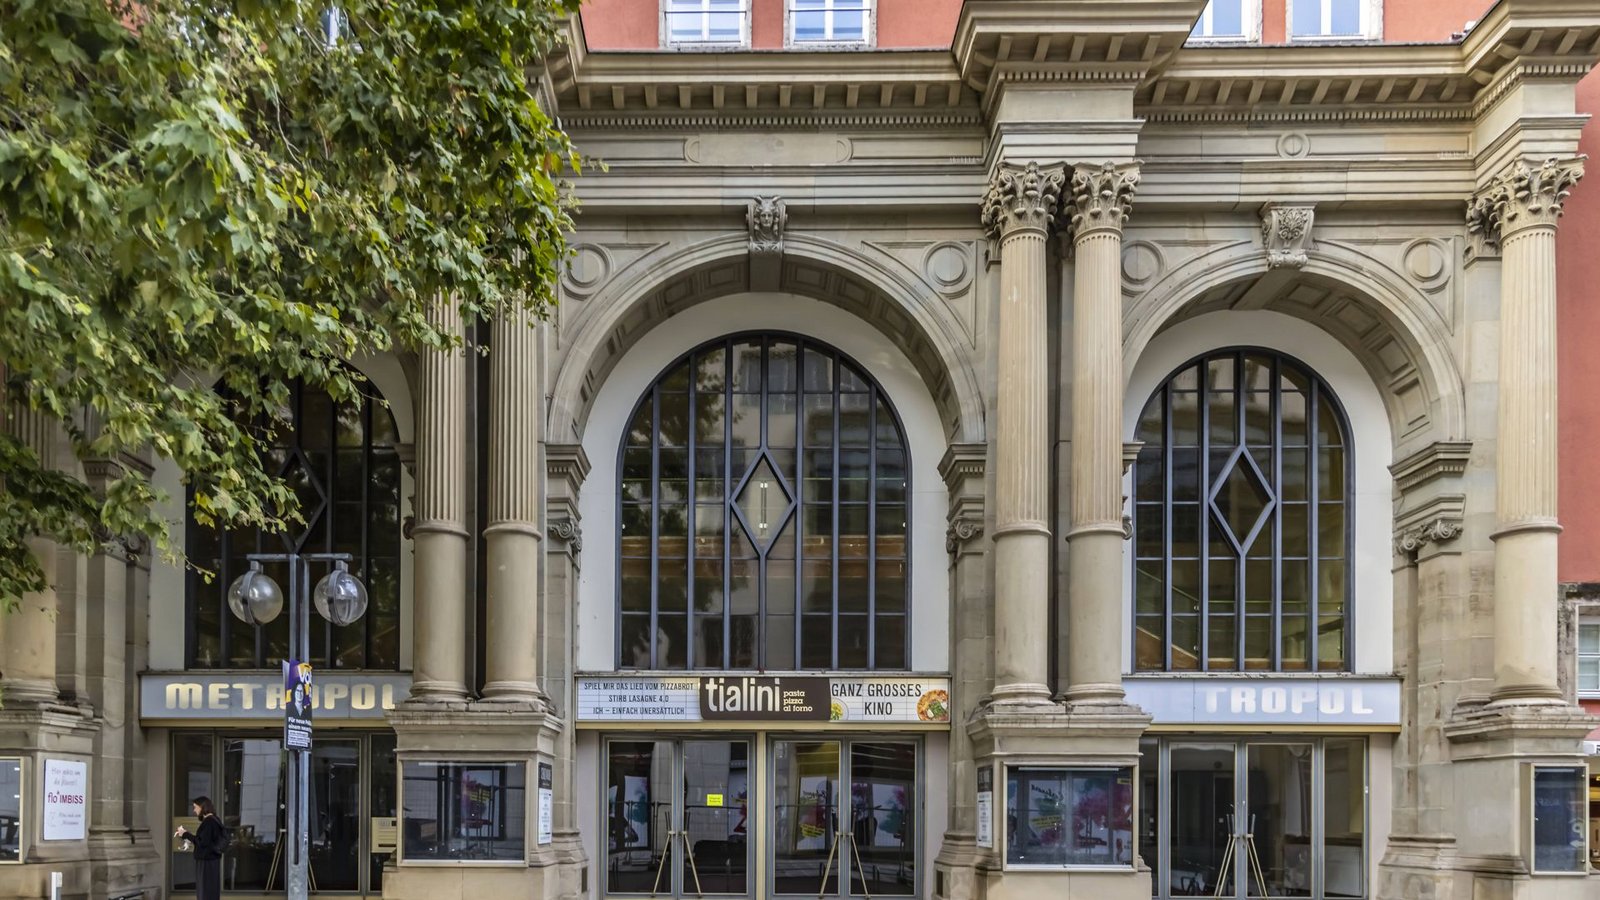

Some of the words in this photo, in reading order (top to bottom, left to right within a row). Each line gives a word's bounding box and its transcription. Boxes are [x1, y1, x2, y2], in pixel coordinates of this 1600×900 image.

[584, 682, 600, 690] SPIEL
[603, 682, 615, 690] MIR
[616, 682, 628, 690] DAS
[630, 682, 643, 690] LIED
[645, 682, 659, 690] VOM
[660, 682, 694, 691] PIZZABROT
[831, 683, 863, 697] GANZ
[867, 683, 922, 697] GROSSES
[705, 677, 780, 712] tialini
[783, 690, 805, 698] pasta
[608, 695, 627, 703] STIRB
[628, 695, 657, 703] LASAGNE
[659, 695, 670, 703] 4.0
[783, 698, 804, 706] pizza
[593, 707, 604, 715] ICH
[612, 707, 638, 715] EINFACH
[864, 702, 893, 715] KINO
[59, 794, 84, 805] IMBISS
